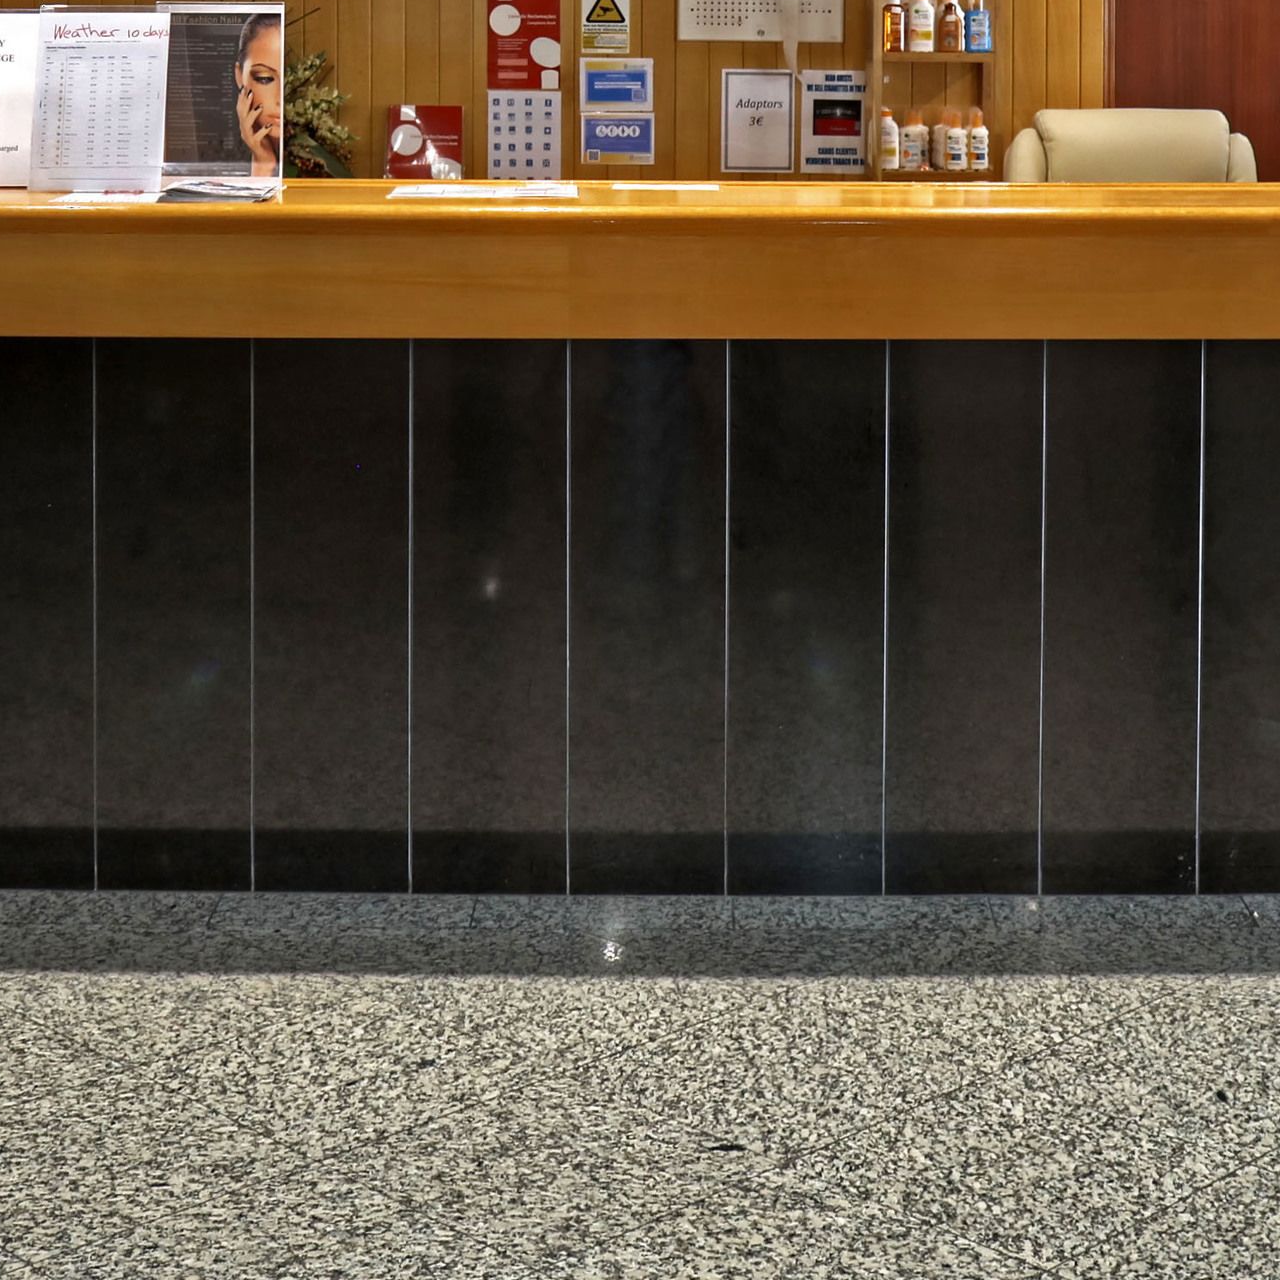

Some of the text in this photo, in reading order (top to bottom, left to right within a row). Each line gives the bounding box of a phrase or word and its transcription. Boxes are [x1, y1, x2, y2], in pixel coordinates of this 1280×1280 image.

[54, 23, 170, 41] Weather 10 days
[736, 98, 783, 111] Adaptors
[749, 116, 764, 127] 3€
